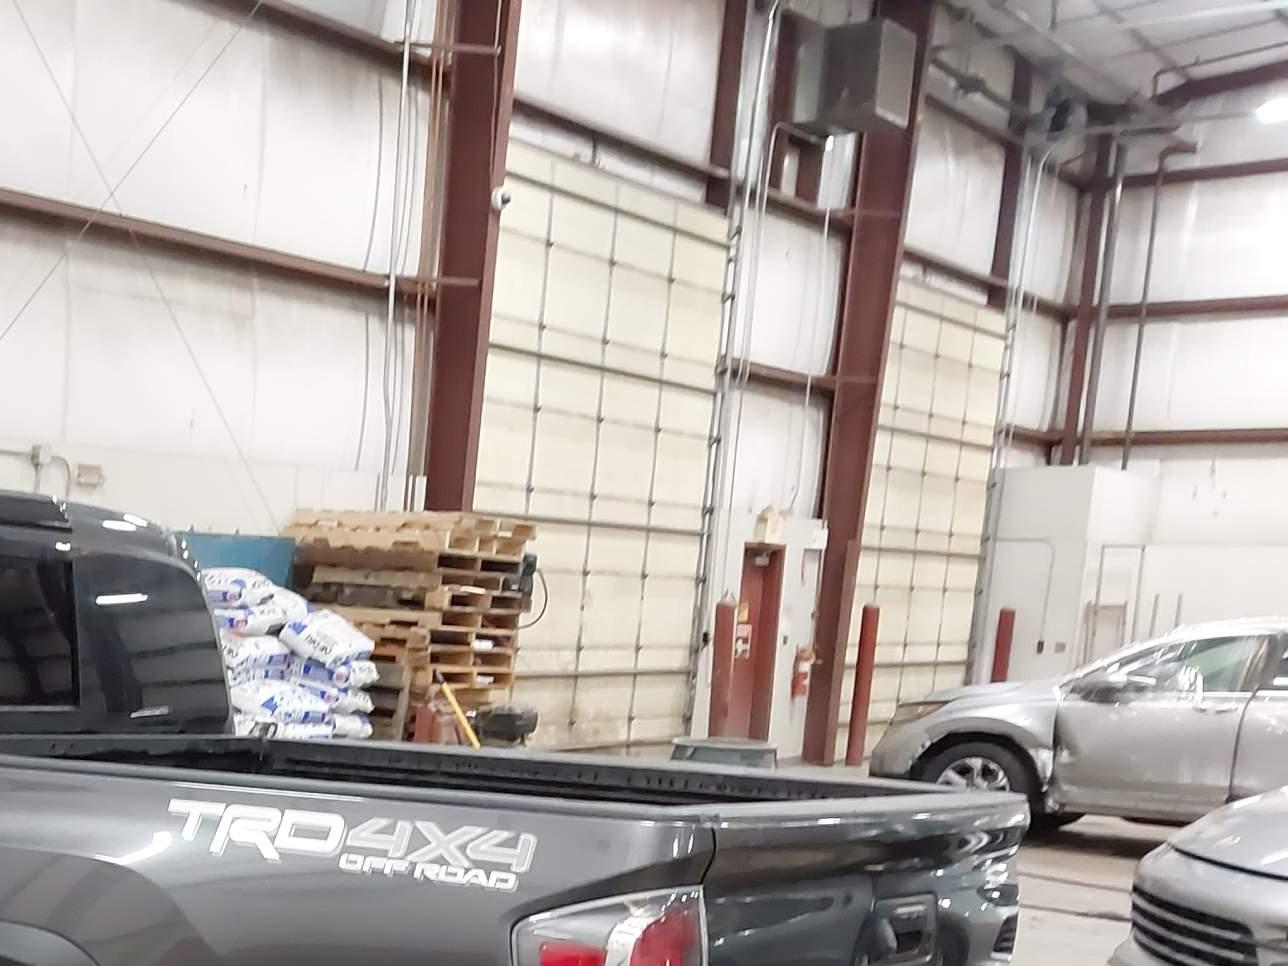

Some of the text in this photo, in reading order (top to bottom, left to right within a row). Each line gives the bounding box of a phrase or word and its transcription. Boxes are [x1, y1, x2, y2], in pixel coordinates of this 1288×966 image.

[168, 798, 347, 863] TRD
[338, 852, 520, 892] OFF ROAD
